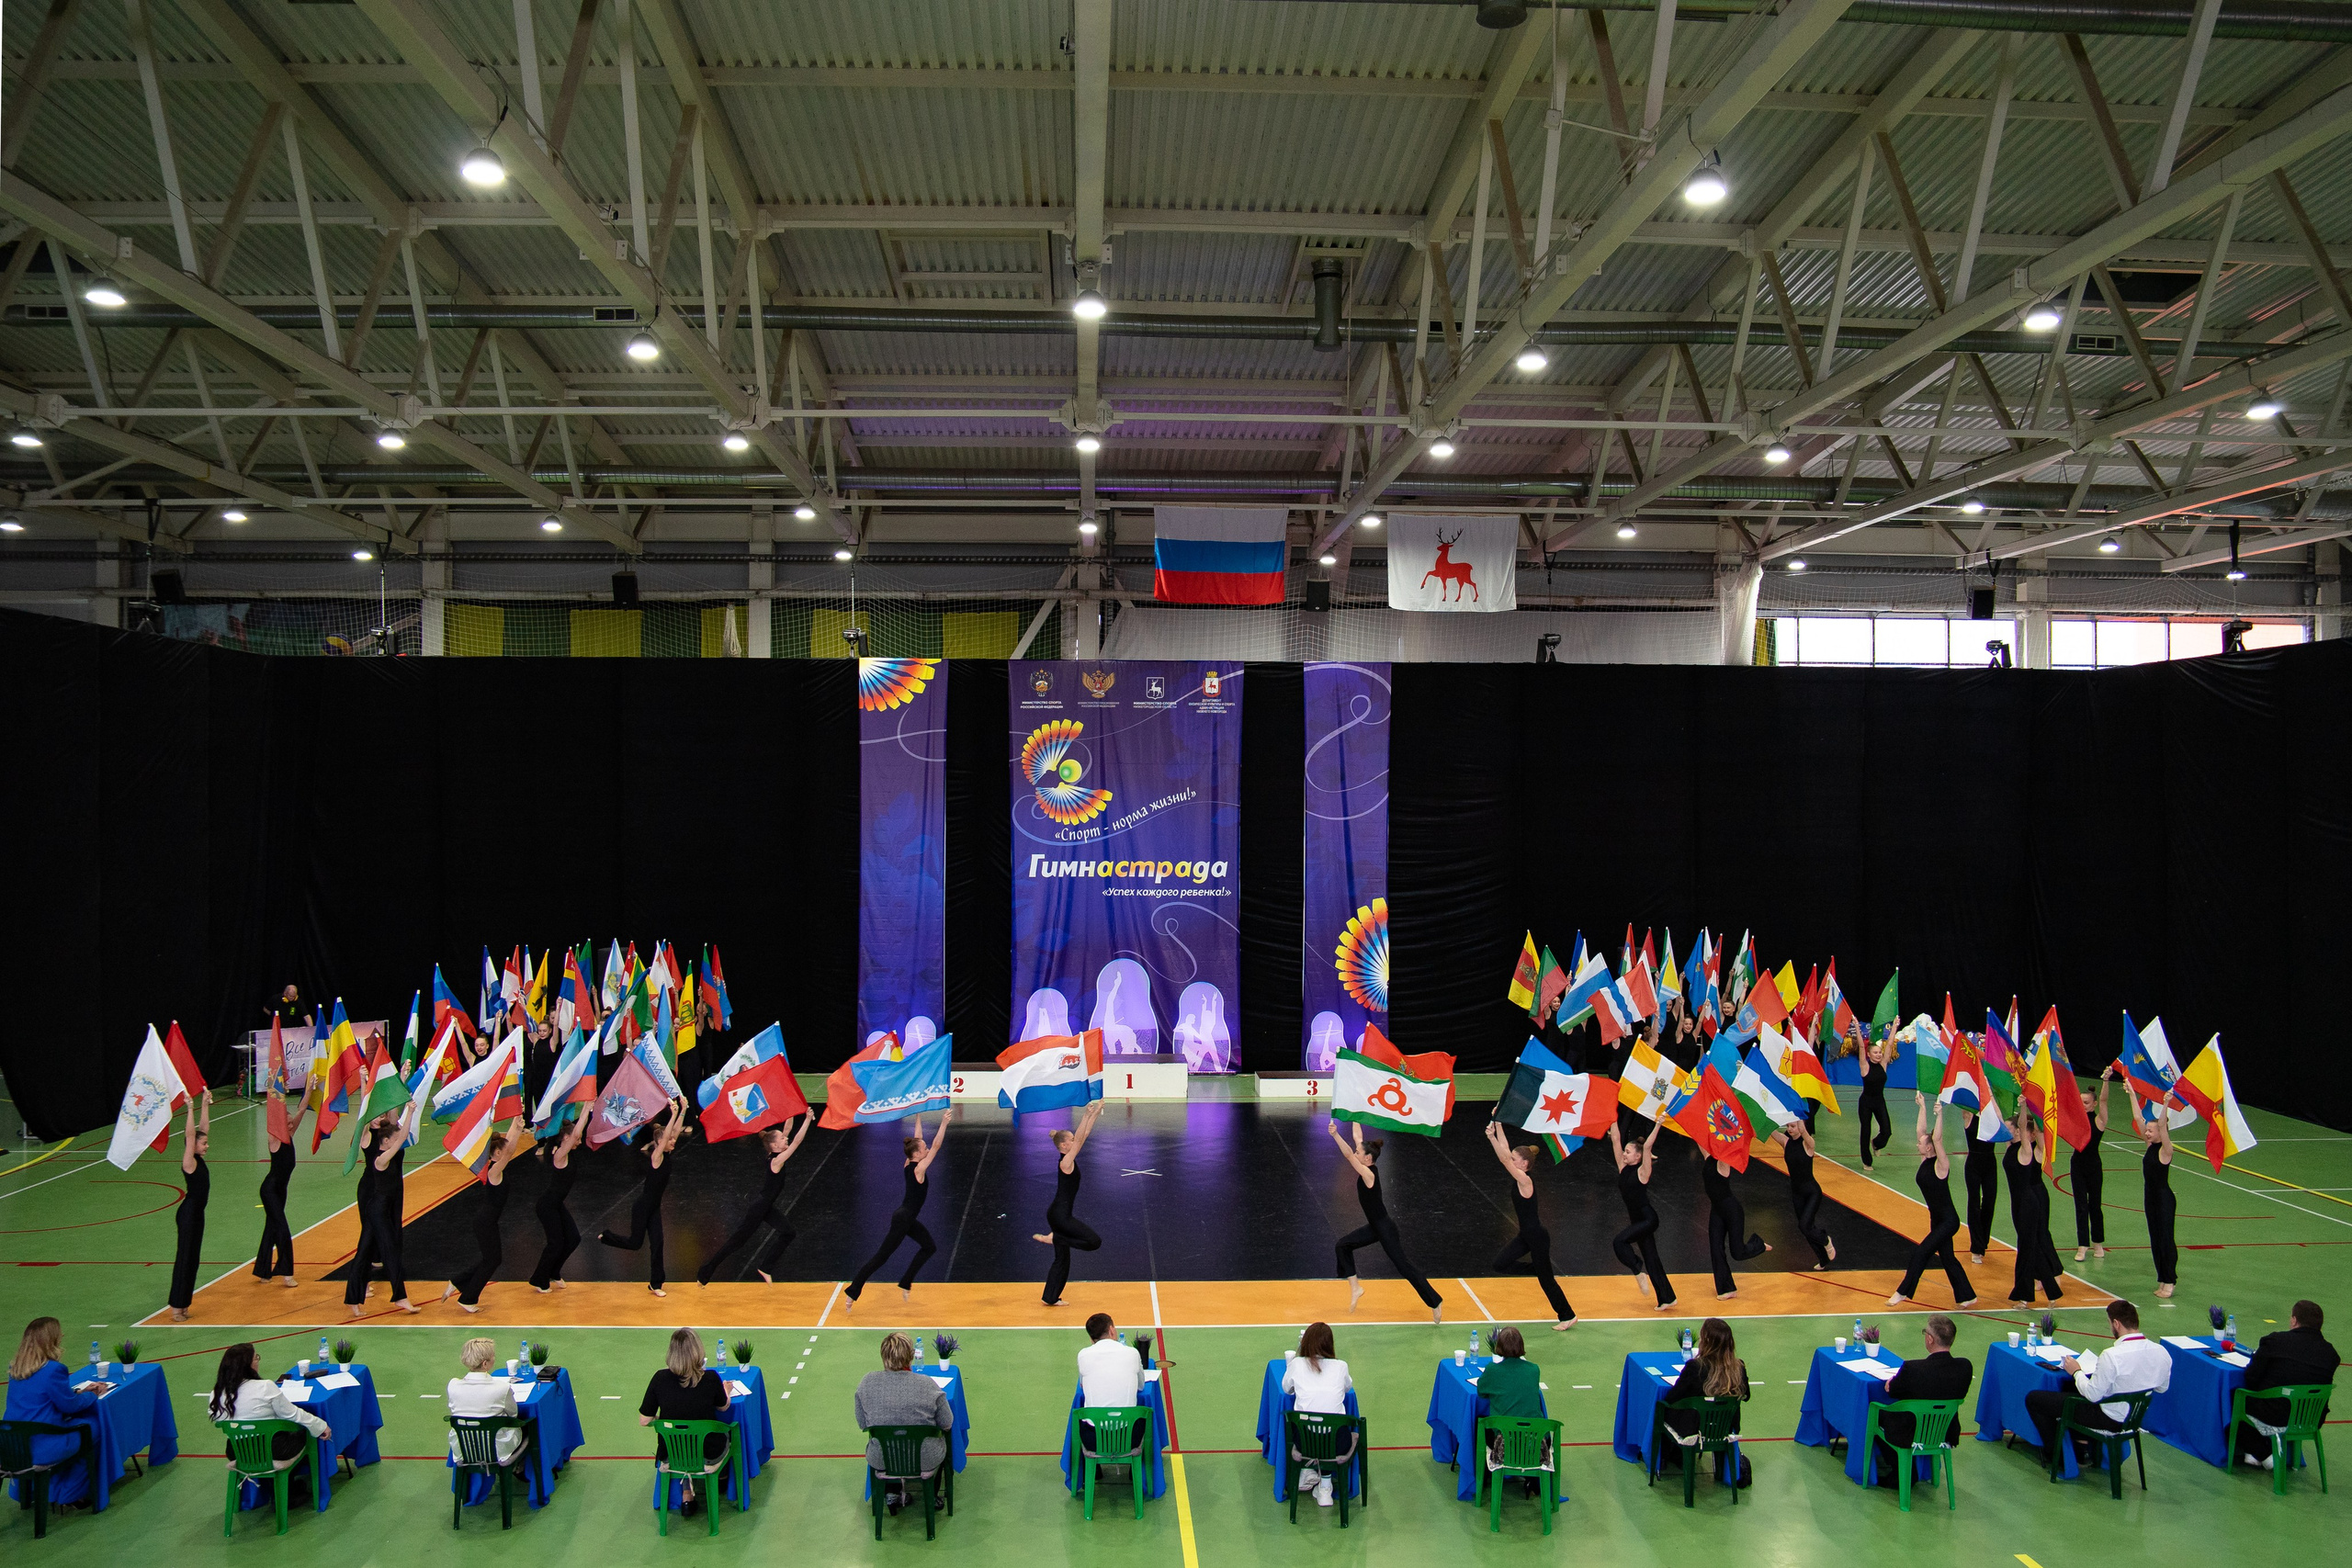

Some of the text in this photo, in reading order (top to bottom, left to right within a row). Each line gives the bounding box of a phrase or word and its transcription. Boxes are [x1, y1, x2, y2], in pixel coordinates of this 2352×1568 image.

[1055, 826, 1101, 843] «Спорт
[1112, 807, 1148, 830] норма
[1149, 787, 1196, 813] жизни!»
[1028, 853, 1228, 884] Гимнастрада
[1102, 886, 1232, 898] «Успех каждого ребенка!»
[953, 1077, 965, 1093] 2
[1125, 1074, 1134, 1089] 1
[1306, 1080, 1318, 1096] 3
